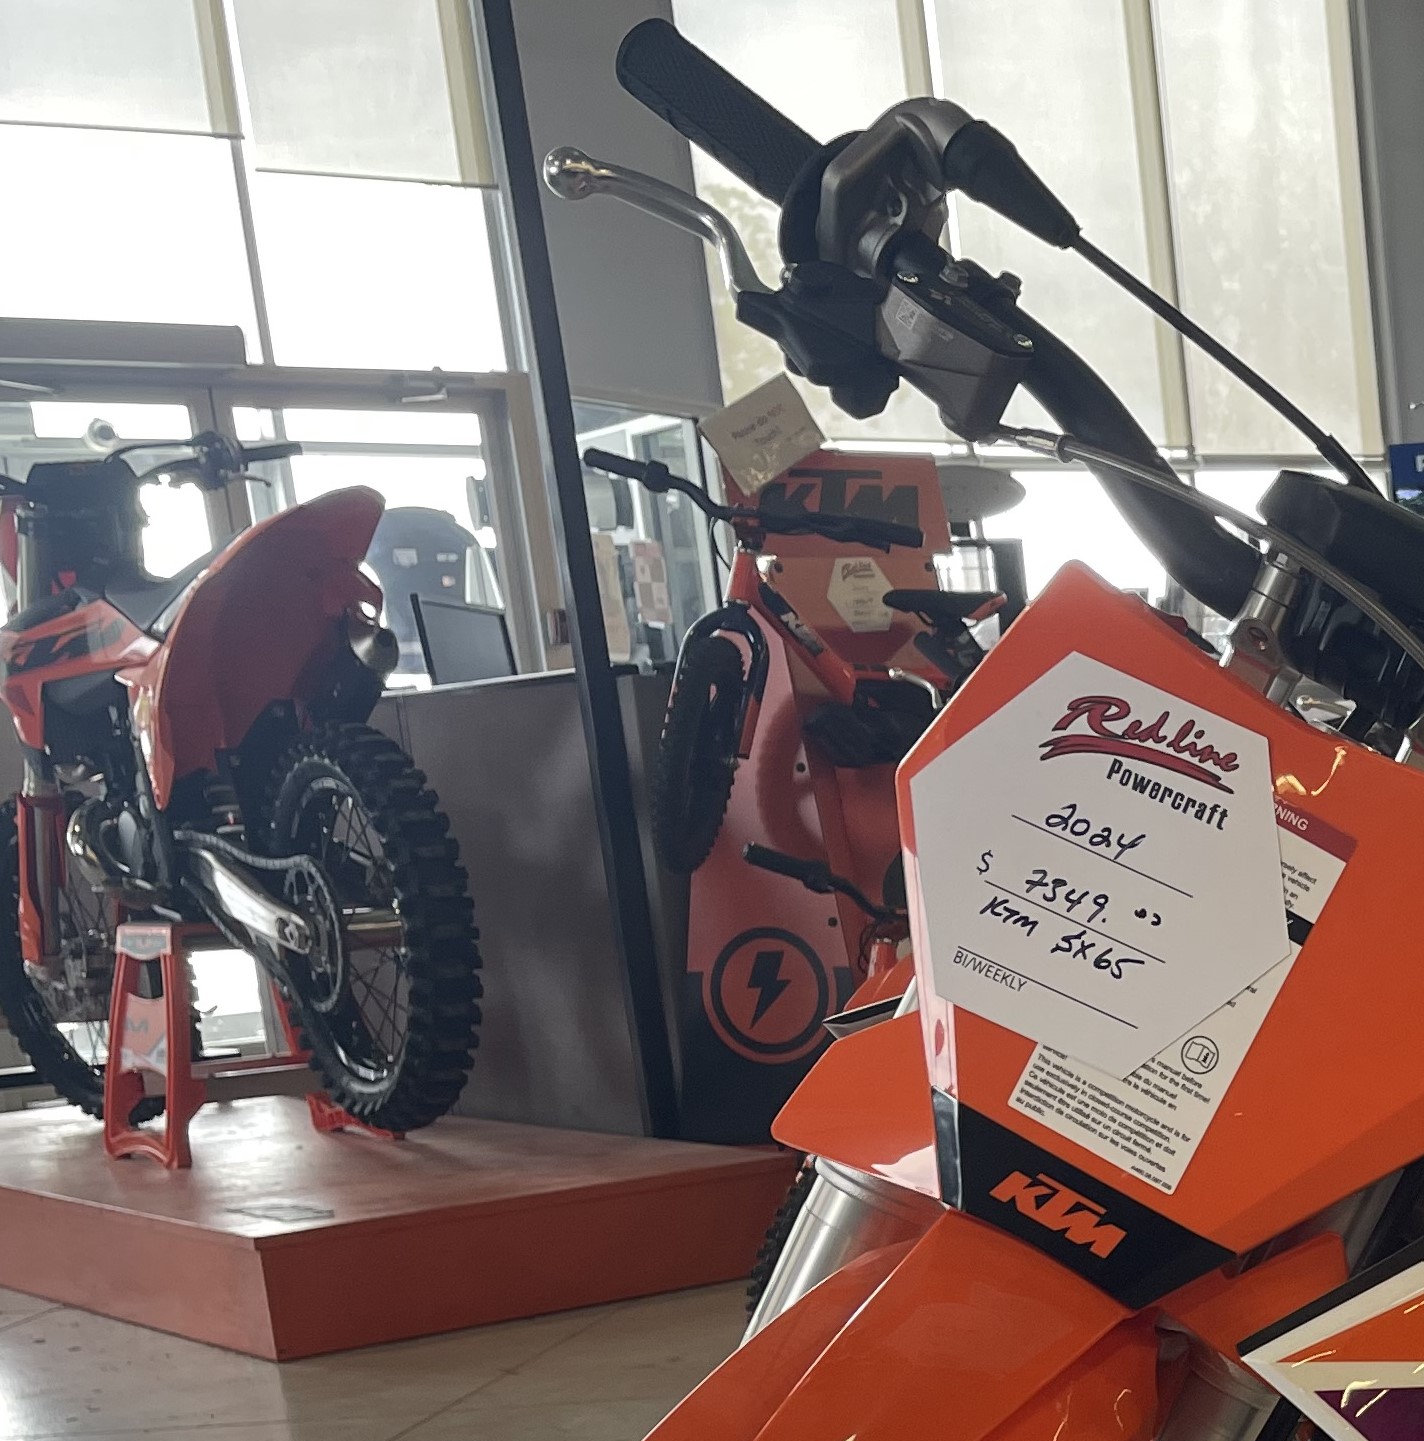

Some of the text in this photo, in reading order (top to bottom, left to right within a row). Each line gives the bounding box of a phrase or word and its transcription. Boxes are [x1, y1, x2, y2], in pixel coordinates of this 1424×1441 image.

[1106, 758, 1229, 831] Powercraft
[1045, 803, 1146, 860] 2024
[979, 895, 1039, 937] KTM
[953, 949, 1028, 993] BI/WEEKLY
[989, 1170, 1128, 1260] KTM
